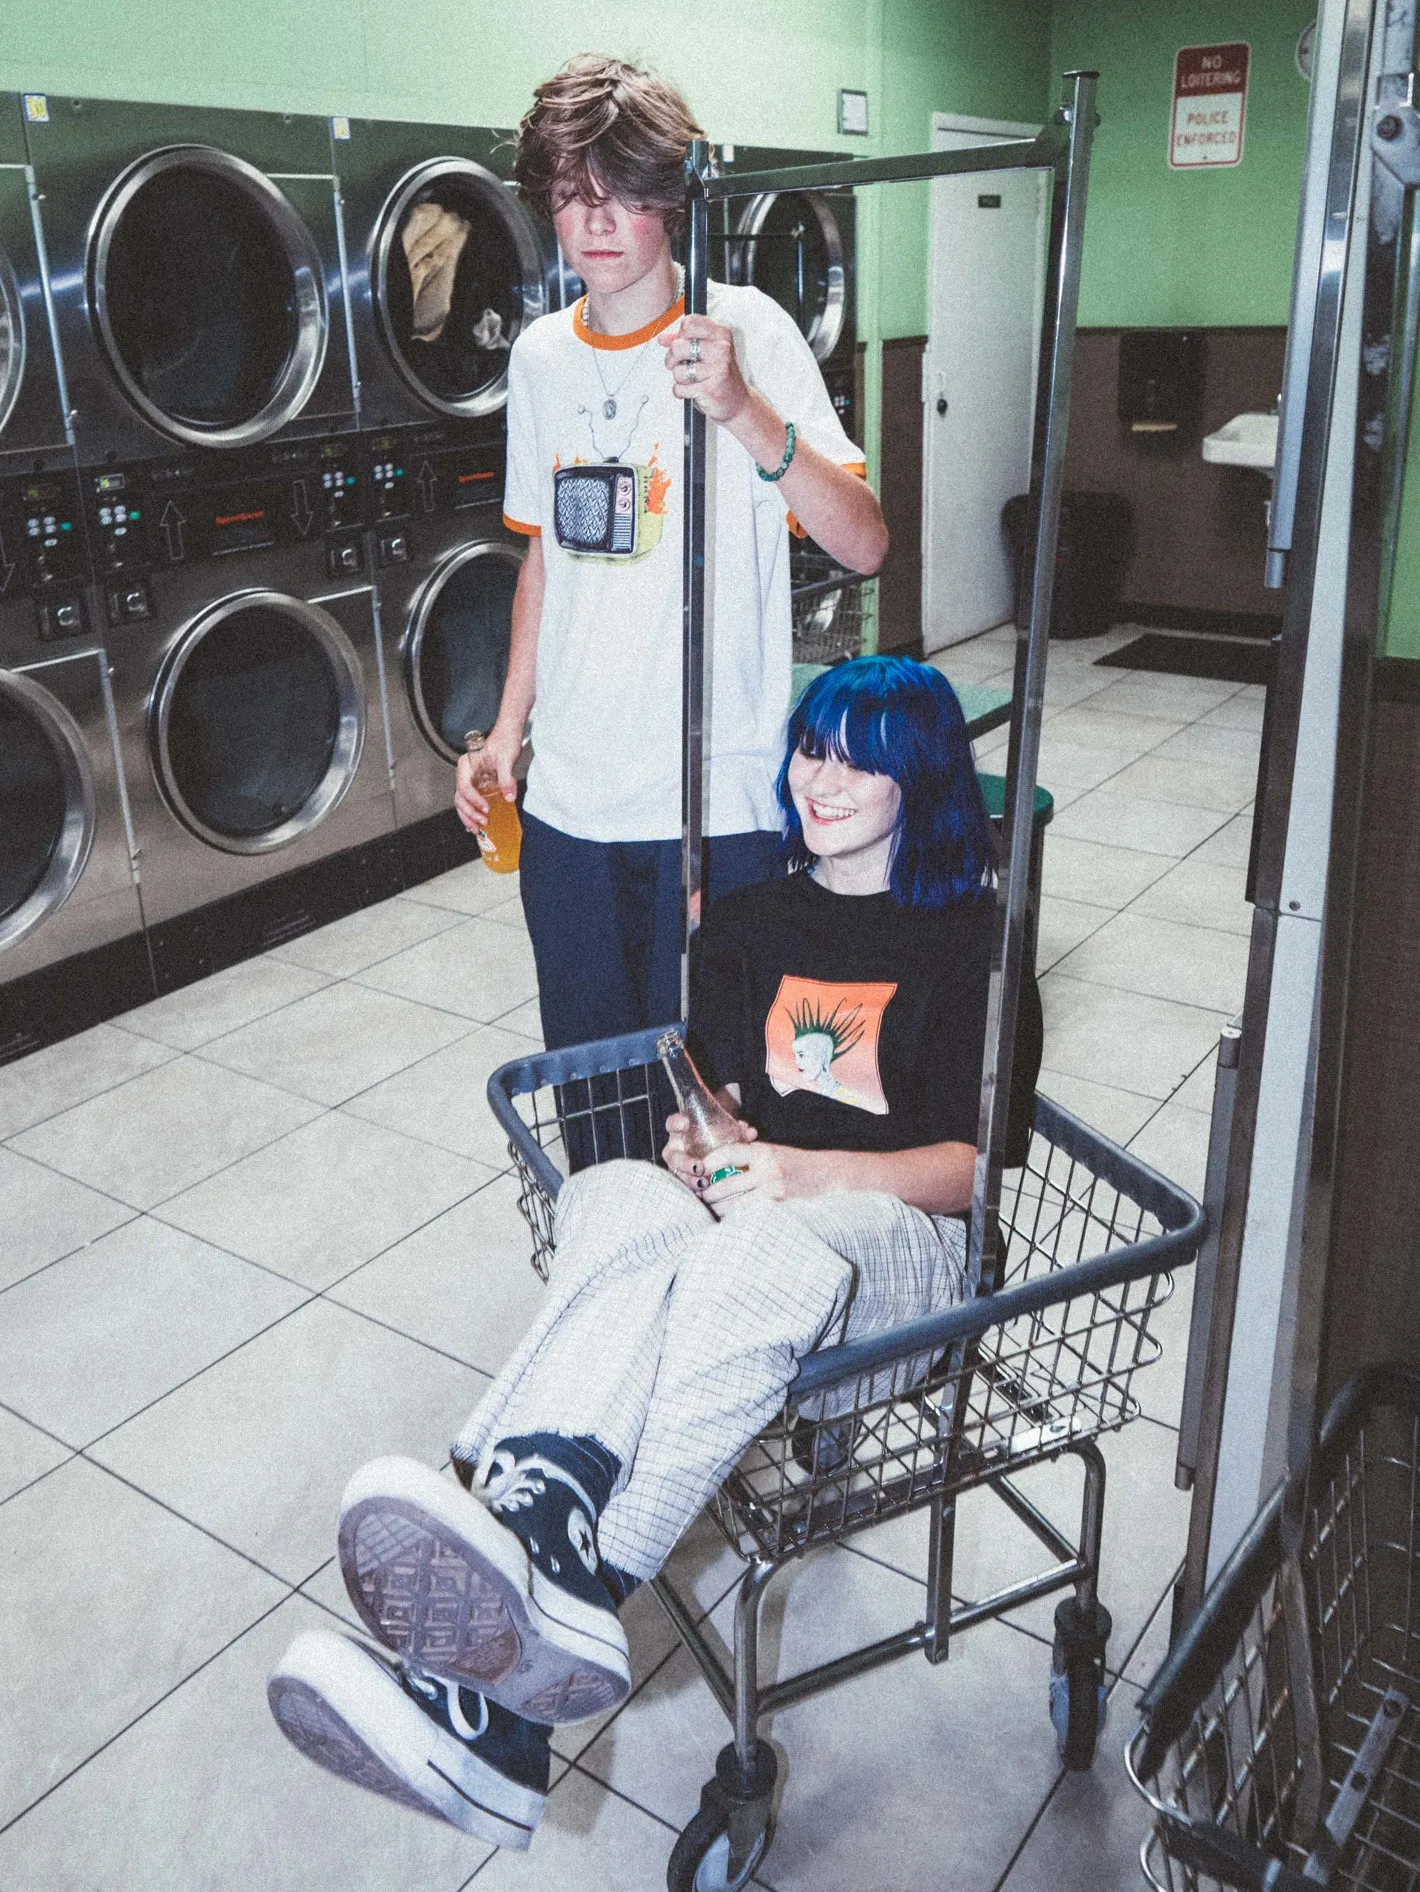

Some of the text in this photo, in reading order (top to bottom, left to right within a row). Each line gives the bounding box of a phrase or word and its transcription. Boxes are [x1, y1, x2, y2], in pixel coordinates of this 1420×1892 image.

[1202, 55, 1222, 69] NO
[1180, 70, 1241, 88] LOITERING
[1187, 111, 1228, 124] POLICE
[1176, 131, 1236, 147] ENFORCED
